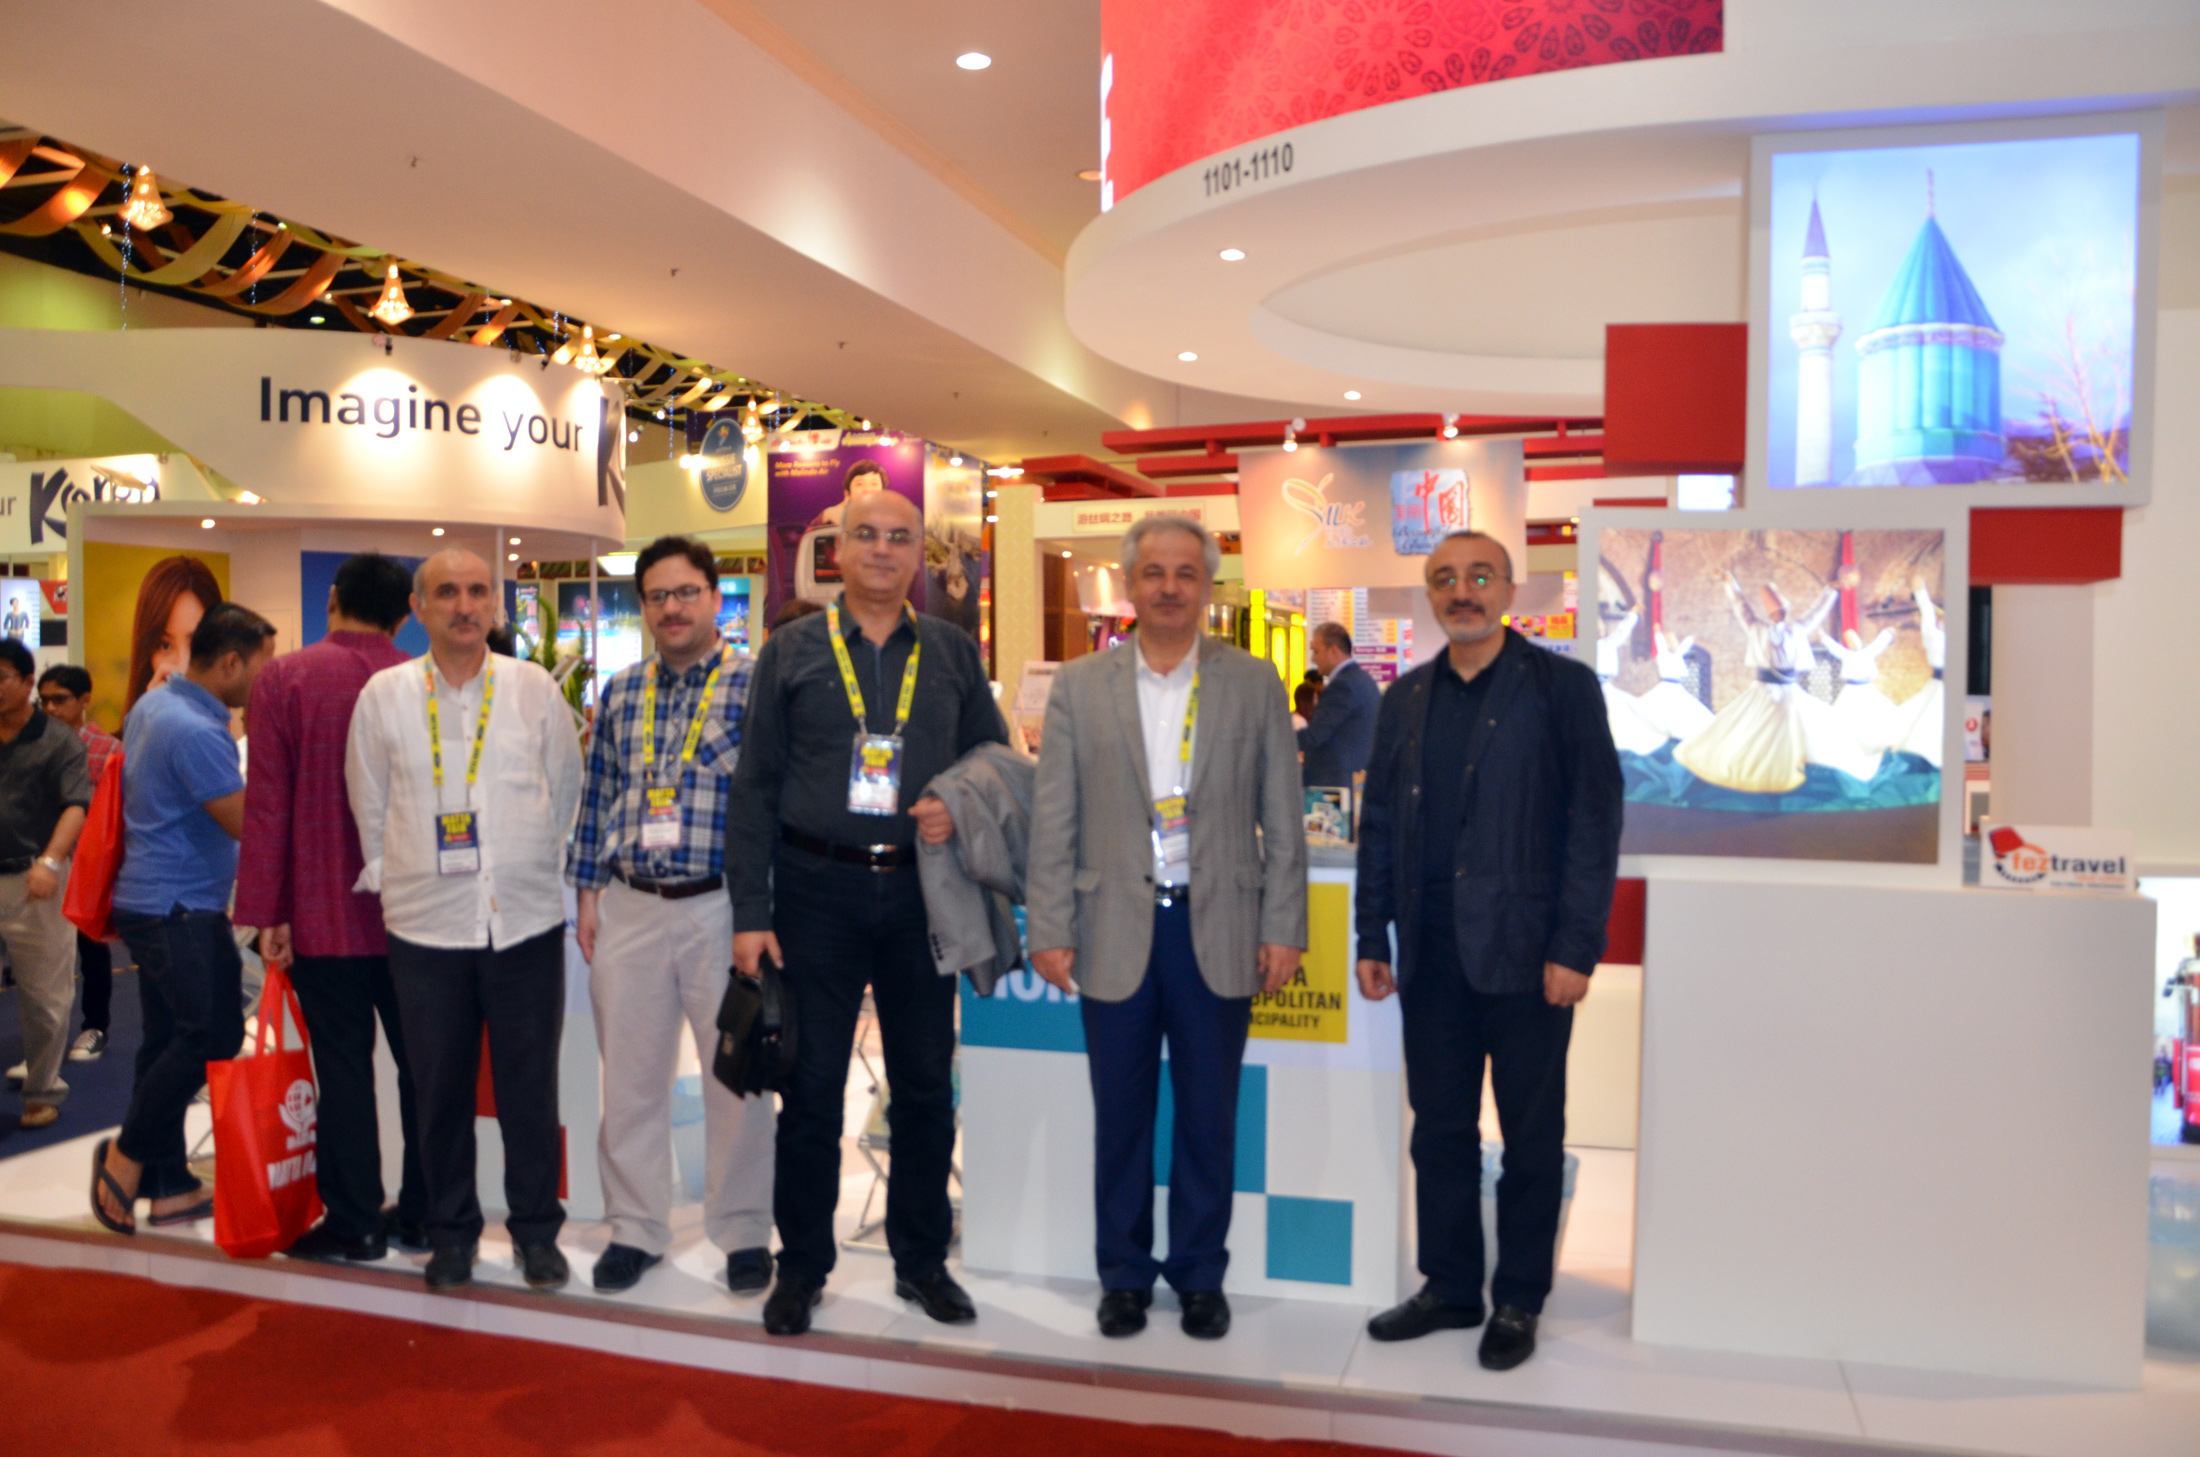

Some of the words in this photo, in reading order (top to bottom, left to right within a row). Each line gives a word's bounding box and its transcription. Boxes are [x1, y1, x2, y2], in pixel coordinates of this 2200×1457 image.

[1203, 142, 1294, 197] 1101-1110
[260, 376, 482, 438] Imagine
[502, 410, 583, 452] your
